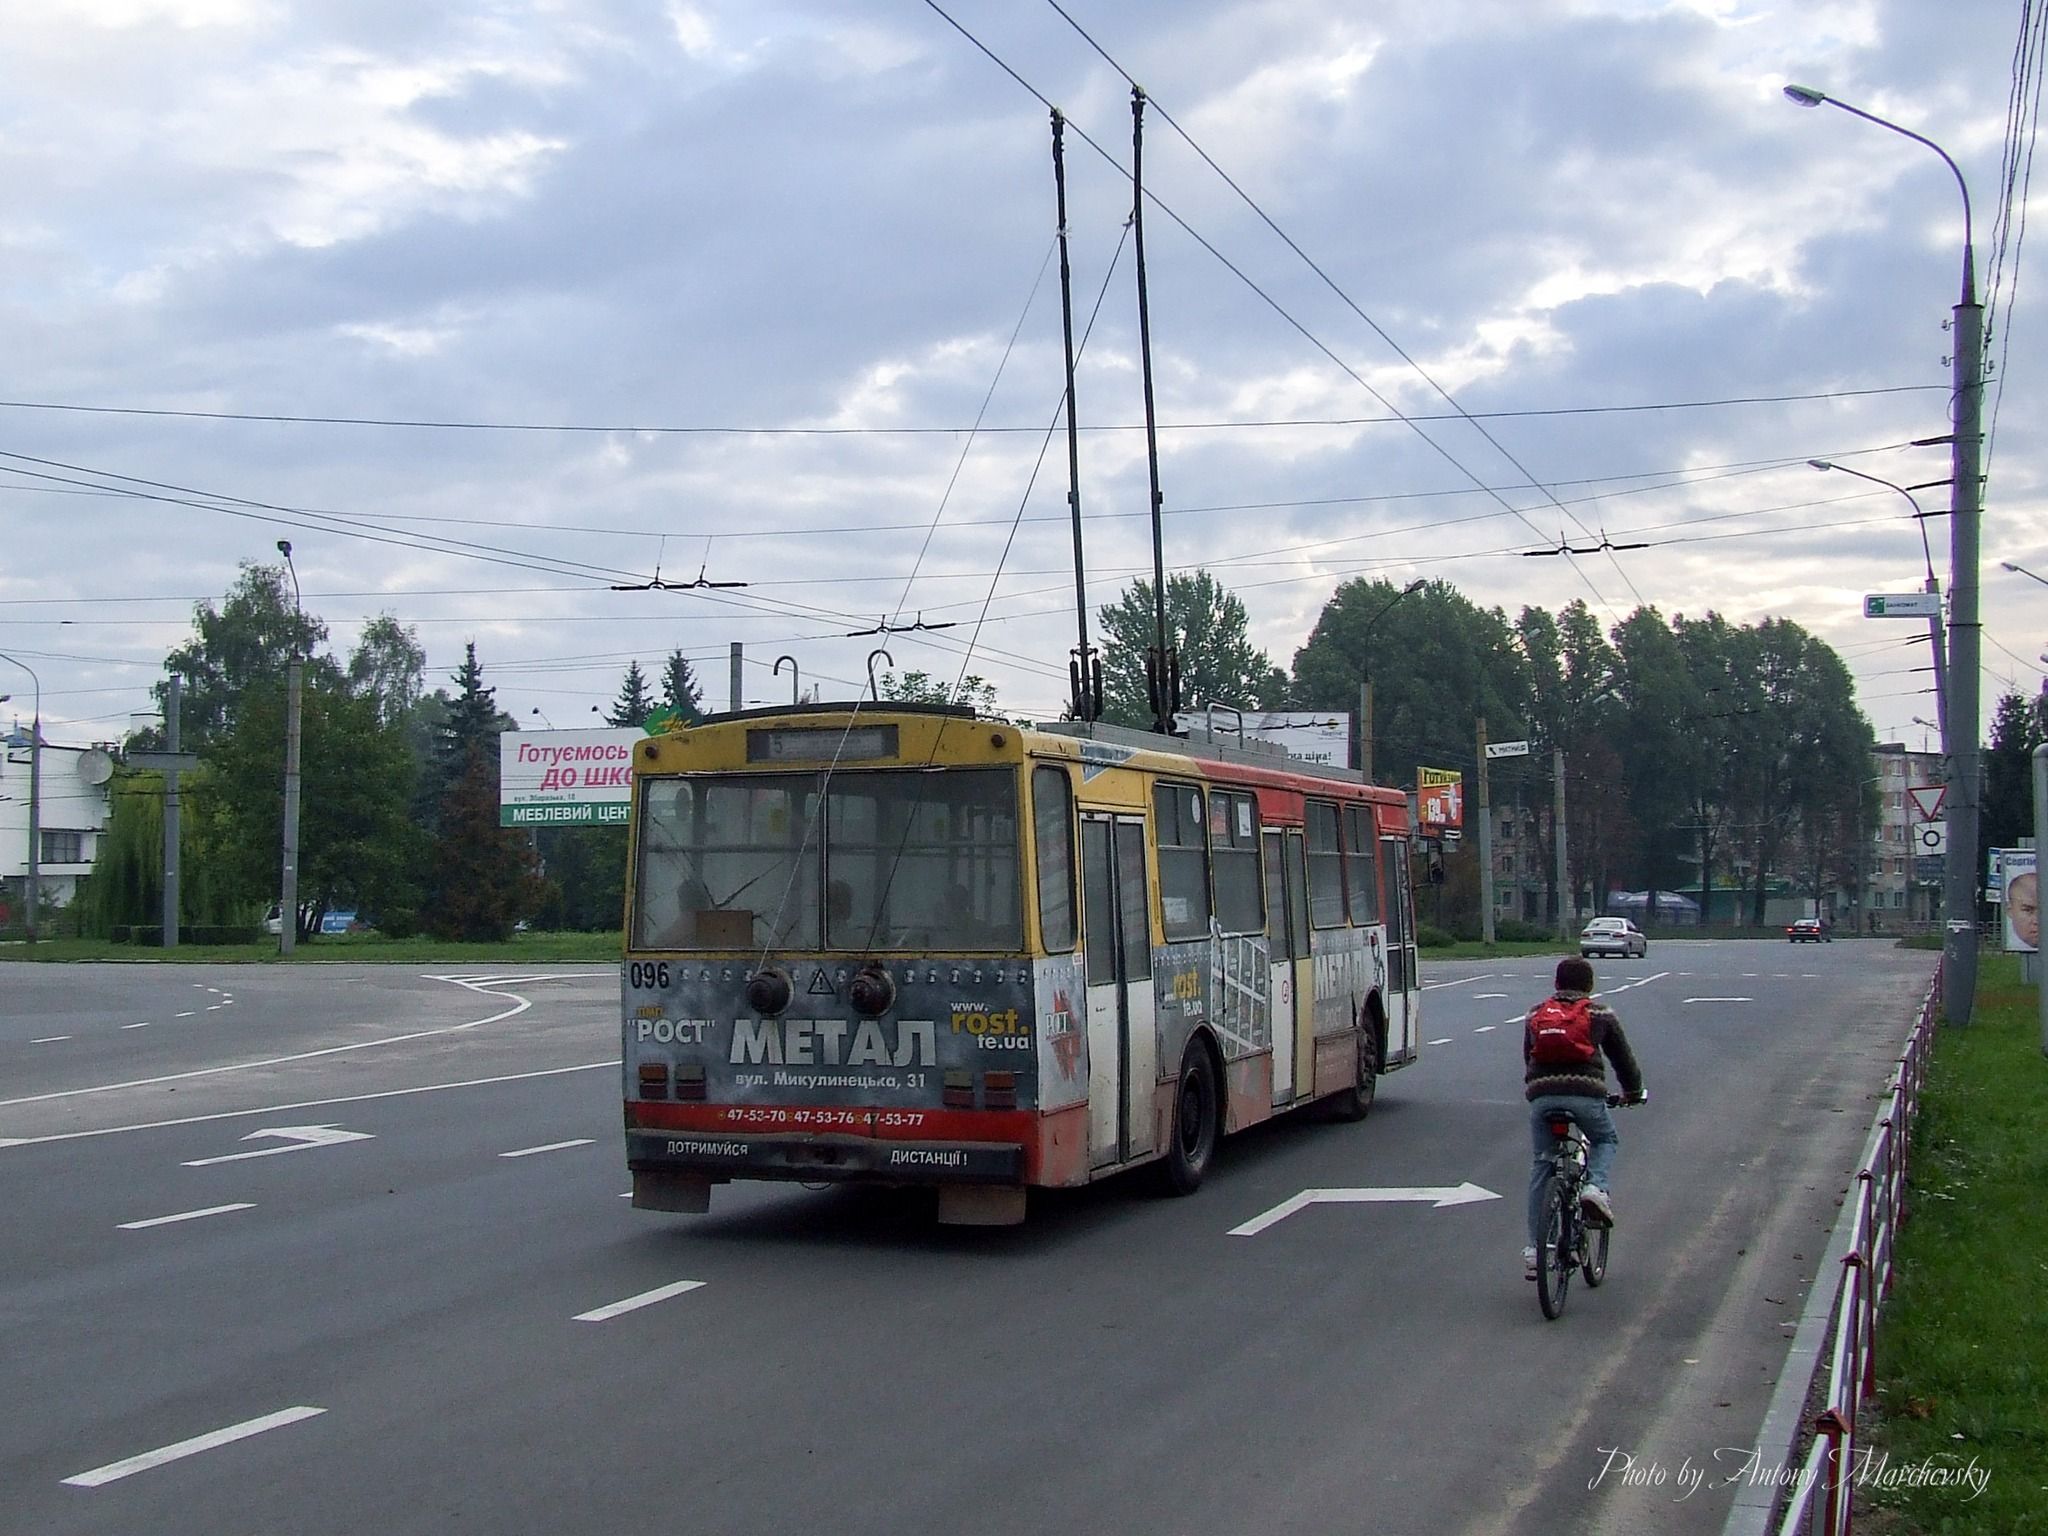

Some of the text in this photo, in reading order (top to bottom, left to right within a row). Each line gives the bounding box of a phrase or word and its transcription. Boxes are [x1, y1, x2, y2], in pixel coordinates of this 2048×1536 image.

[518, 743, 629, 767] Готуємось
[540, 767, 577, 791] ДО
[513, 804, 592, 821] МЕБЛЕВИЙ
[630, 962, 670, 989] 096
[951, 1001, 989, 1012] www.
[627, 1018, 716, 1043] "РОСТ"
[951, 1008, 1031, 1036] rost.
[729, 1018, 936, 1067] МЕТАЛ
[977, 1034, 1030, 1050] te.ua
[735, 1071, 926, 1089] вул. Микулинецька, 31
[727, 1109, 924, 1126] 47-53-70 47-53-76 47-53-77
[667, 1140, 748, 1156] ДОТРИМУЙСЯ
